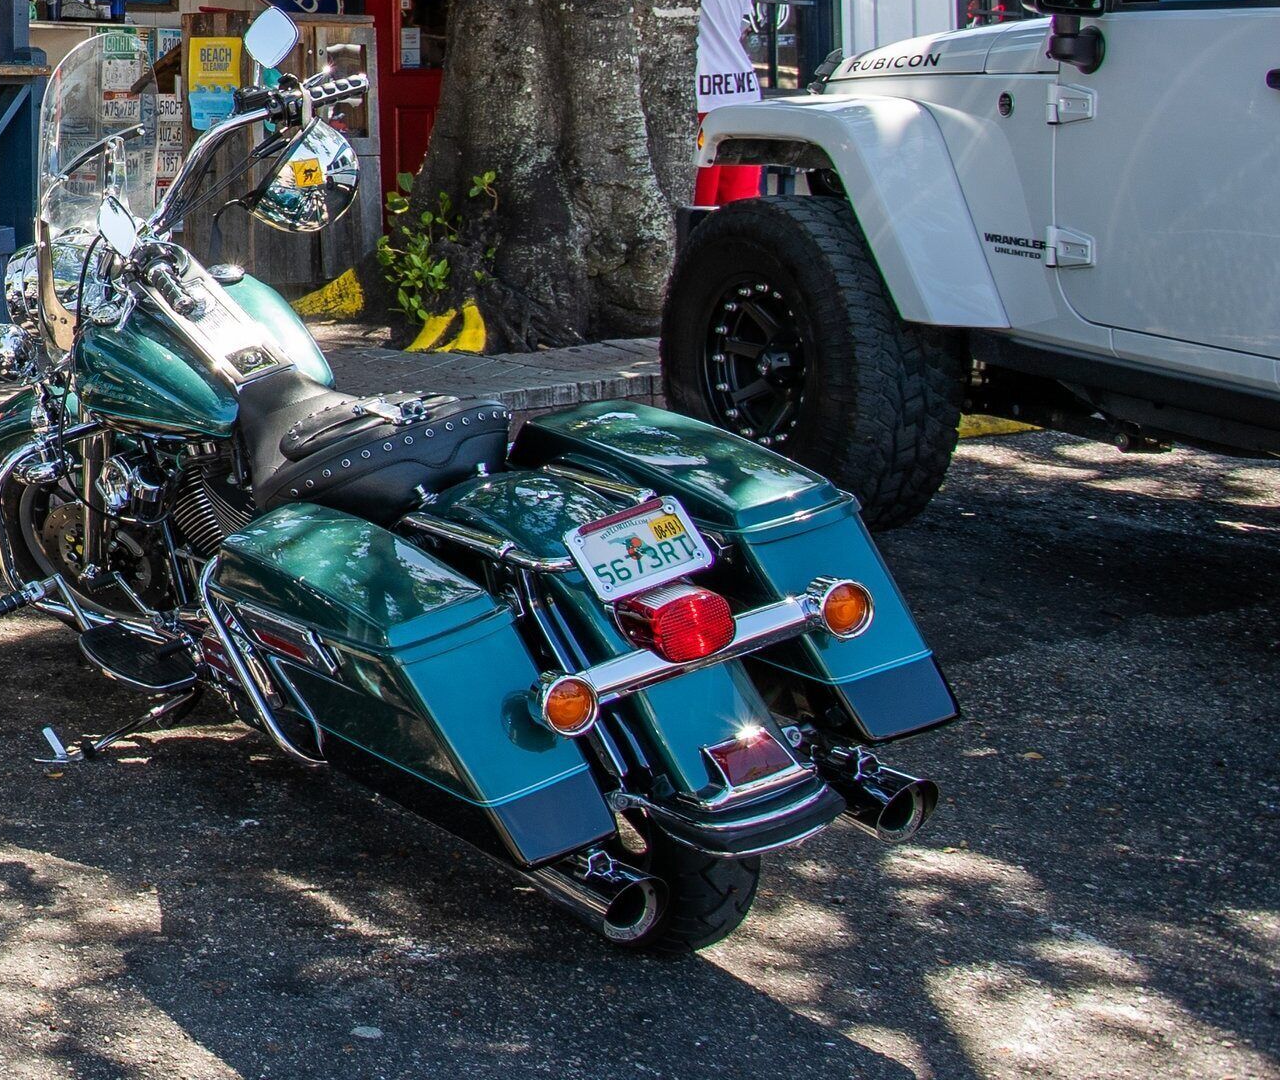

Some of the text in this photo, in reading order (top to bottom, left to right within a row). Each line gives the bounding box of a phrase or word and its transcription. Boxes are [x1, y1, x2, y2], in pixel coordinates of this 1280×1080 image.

[200, 48, 232, 62] BEACH
[847, 53, 942, 73] RUBICON
[202, 62, 229, 71] CLEANUP
[699, 71, 758, 95] DREWE
[984, 232, 1046, 250] WRANGLER
[994, 245, 1041, 260] UNLIMITED
